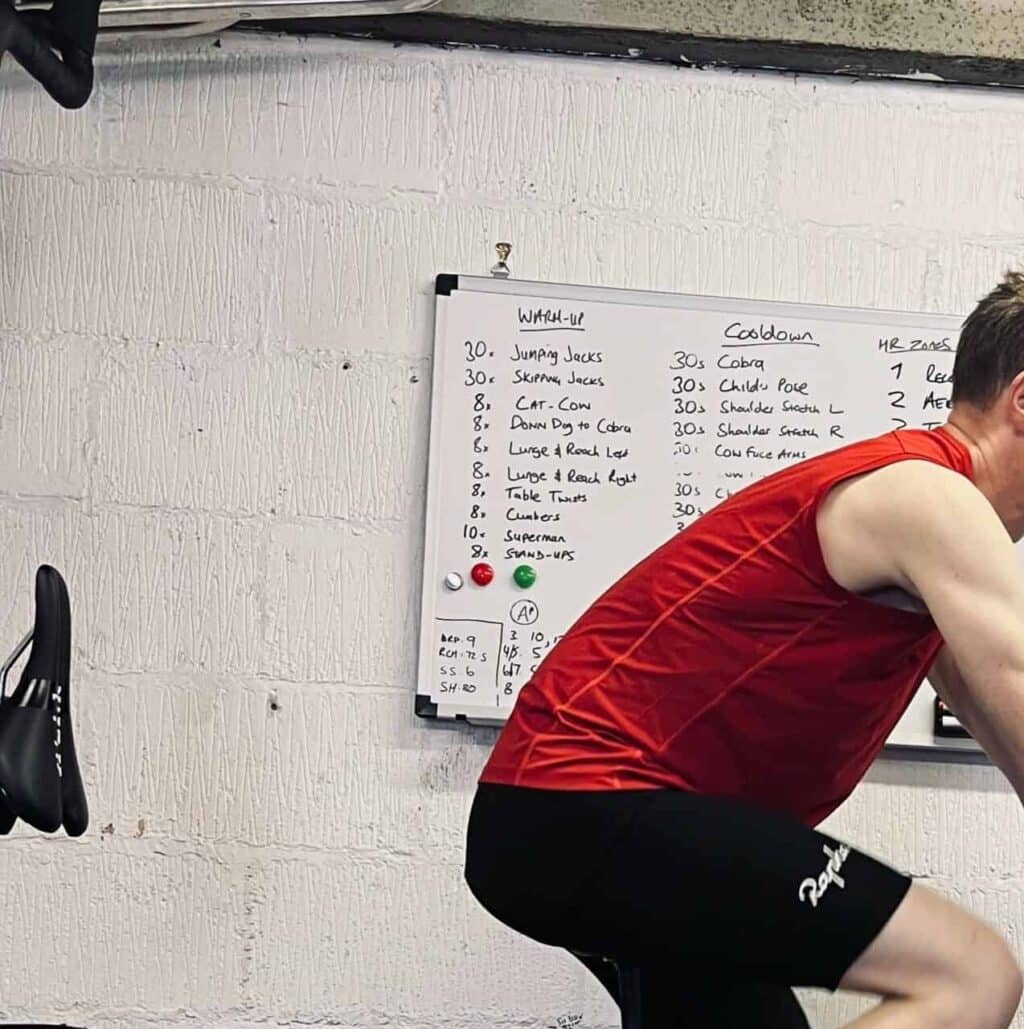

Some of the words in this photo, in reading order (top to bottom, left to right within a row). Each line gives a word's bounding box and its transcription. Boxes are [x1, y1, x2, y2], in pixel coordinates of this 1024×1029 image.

[724, 322, 813, 342] Cooldown
[879, 337, 904, 352] HR
[510, 344, 558, 366] Jumping
[563, 345, 603, 364] Jacks
[717, 354, 764, 372] Cobra
[567, 370, 605, 386] Jacks
[890, 362, 903, 380] 1
[720, 400, 776, 415] Shoulder
[829, 404, 844, 414] L
[887, 391, 906, 408] 2
[551, 417, 573, 437] Dog
[577, 420, 590, 432] to
[595, 418, 631, 434] Cobra
[717, 422, 771, 438] Shoulder
[830, 425, 844, 438] R
[509, 441, 550, 459] Lunge
[507, 466, 547, 484] Lunge
[567, 469, 600, 484] Reach
[504, 486, 542, 503] Table
[504, 527, 566, 544] Superman
[503, 682, 513, 695] 8
